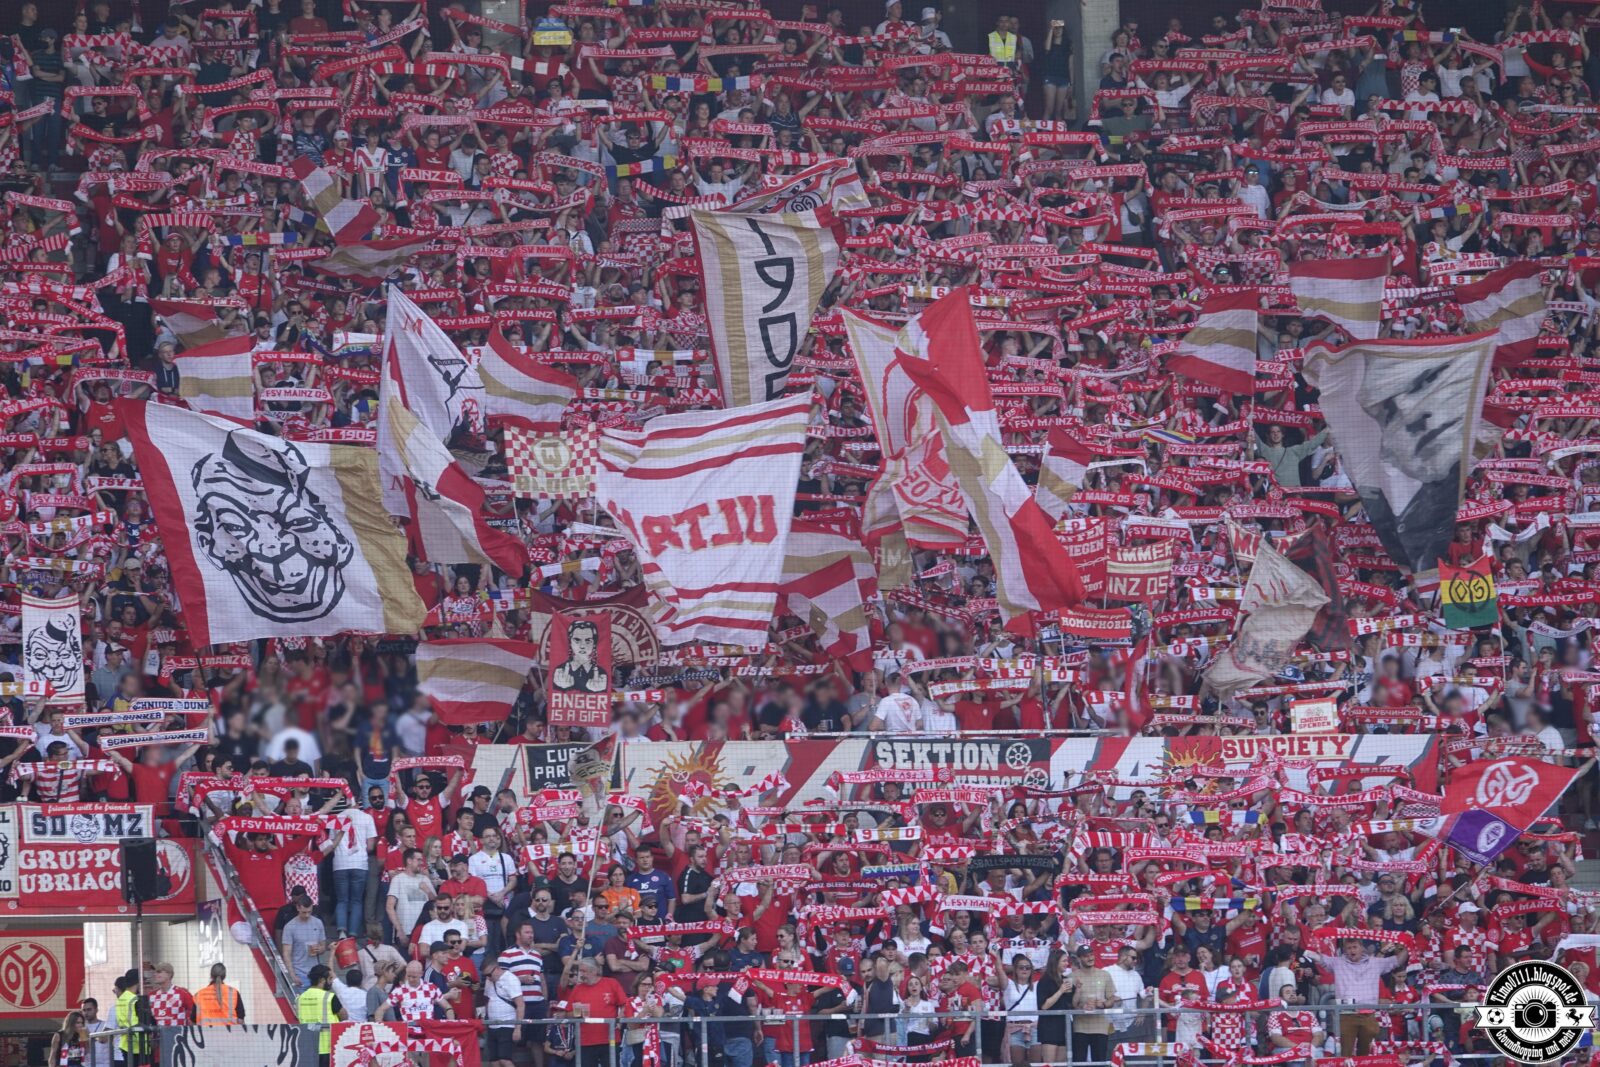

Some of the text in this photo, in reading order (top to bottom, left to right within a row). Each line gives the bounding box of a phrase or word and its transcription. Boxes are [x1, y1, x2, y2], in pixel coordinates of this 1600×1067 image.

[468, 15, 505, 31] MAINZ
[640, 30, 698, 38] FSV MAINZ
[1304, 36, 1370, 52] MAINZ
[965, 83, 998, 91] MAINZ
[807, 117, 834, 128] 1.FSV
[836, 120, 868, 131] MAINZ
[1036, 134, 1052, 142] FSV
[1055, 134, 1084, 142] MAINZ
[970, 141, 1010, 151] TRAUM
[1512, 182, 1568, 196] SEIT 1905
[1028, 254, 1076, 268] MAINZ
[1468, 259, 1500, 269] MOGUN
[420, 291, 455, 300] MAINZ
[437, 316, 490, 326] FSV MAINZ
[1256, 380, 1288, 388] MAINZ
[266, 389, 328, 398] FSV MAINZ 05
[308, 429, 376, 441] SEIT 1905
[1072, 492, 1083, 501] SV
[1085, 492, 1114, 501] MAINZ
[1146, 575, 1168, 595] 05
[1508, 592, 1594, 603] FSV MAINZ 05
[1061, 616, 1132, 630] HOMOPHOBIE
[184, 700, 209, 710] DUNK
[551, 693, 608, 710] ANGER
[68, 715, 113, 725] SCHNUDE
[551, 710, 608, 722] IS A GIFT
[876, 741, 1000, 771] SEKTION
[916, 790, 987, 803] ÄMPFEN UND SIE
[1302, 792, 1326, 804] FSV
[1329, 790, 1367, 804] MAINZ
[32, 813, 66, 835] SD
[105, 813, 142, 835] MZ
[240, 820, 262, 829] FSV
[265, 820, 302, 830] MAINZ
[305, 822, 318, 832] 05
[738, 869, 757, 879] FSV
[759, 868, 792, 876] MAINZ
[1497, 900, 1554, 915] FSV MAINZ
[816, 907, 884, 921] FSV MAINZ
[639, 924, 661, 934] FSV
[665, 922, 703, 932] MAINZ
[705, 921, 721, 930] 05
[760, 970, 837, 984] FSV MAINZ 05
